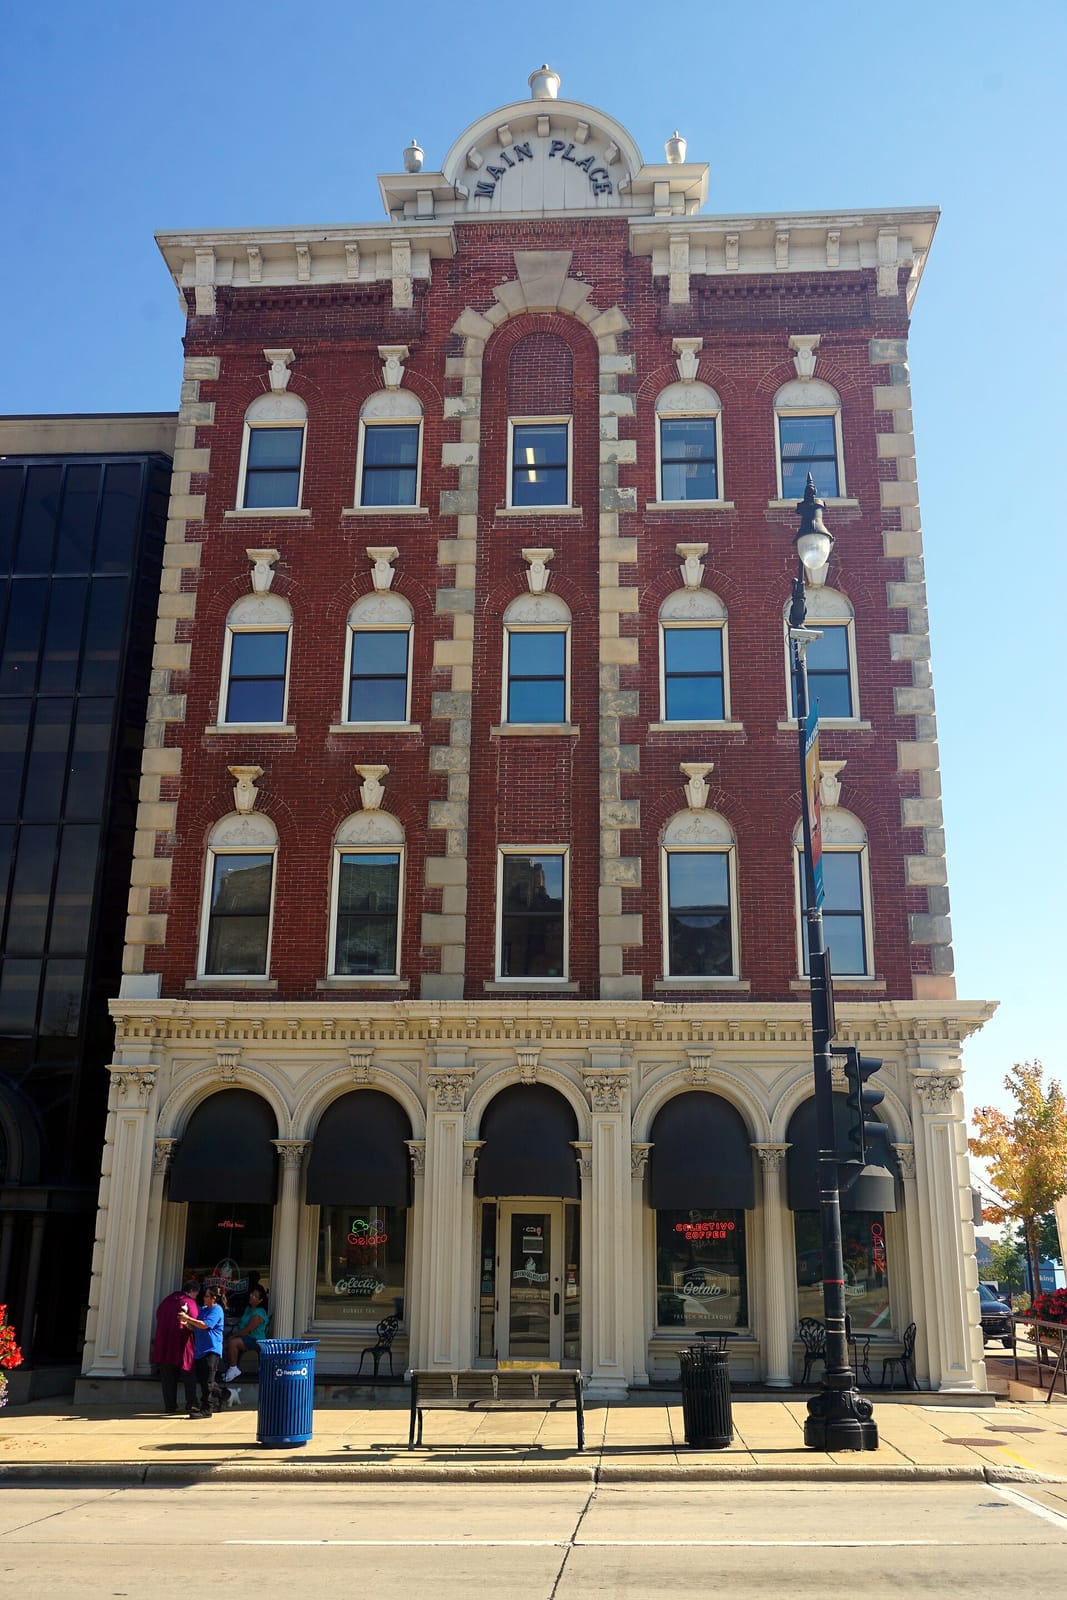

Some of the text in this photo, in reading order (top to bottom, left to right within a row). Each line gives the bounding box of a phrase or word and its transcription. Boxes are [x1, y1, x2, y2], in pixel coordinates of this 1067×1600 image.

[474, 140, 613, 199] MAIN PLACE
[675, 1221, 735, 1232] COLECTIVO
[347, 1233, 388, 1246] Gelato
[685, 1230, 727, 1240] COFFEE
[870, 1223, 885, 1273] OPEN
[334, 1277, 385, 1295] Colectivo
[683, 1281, 721, 1296] Gelato
